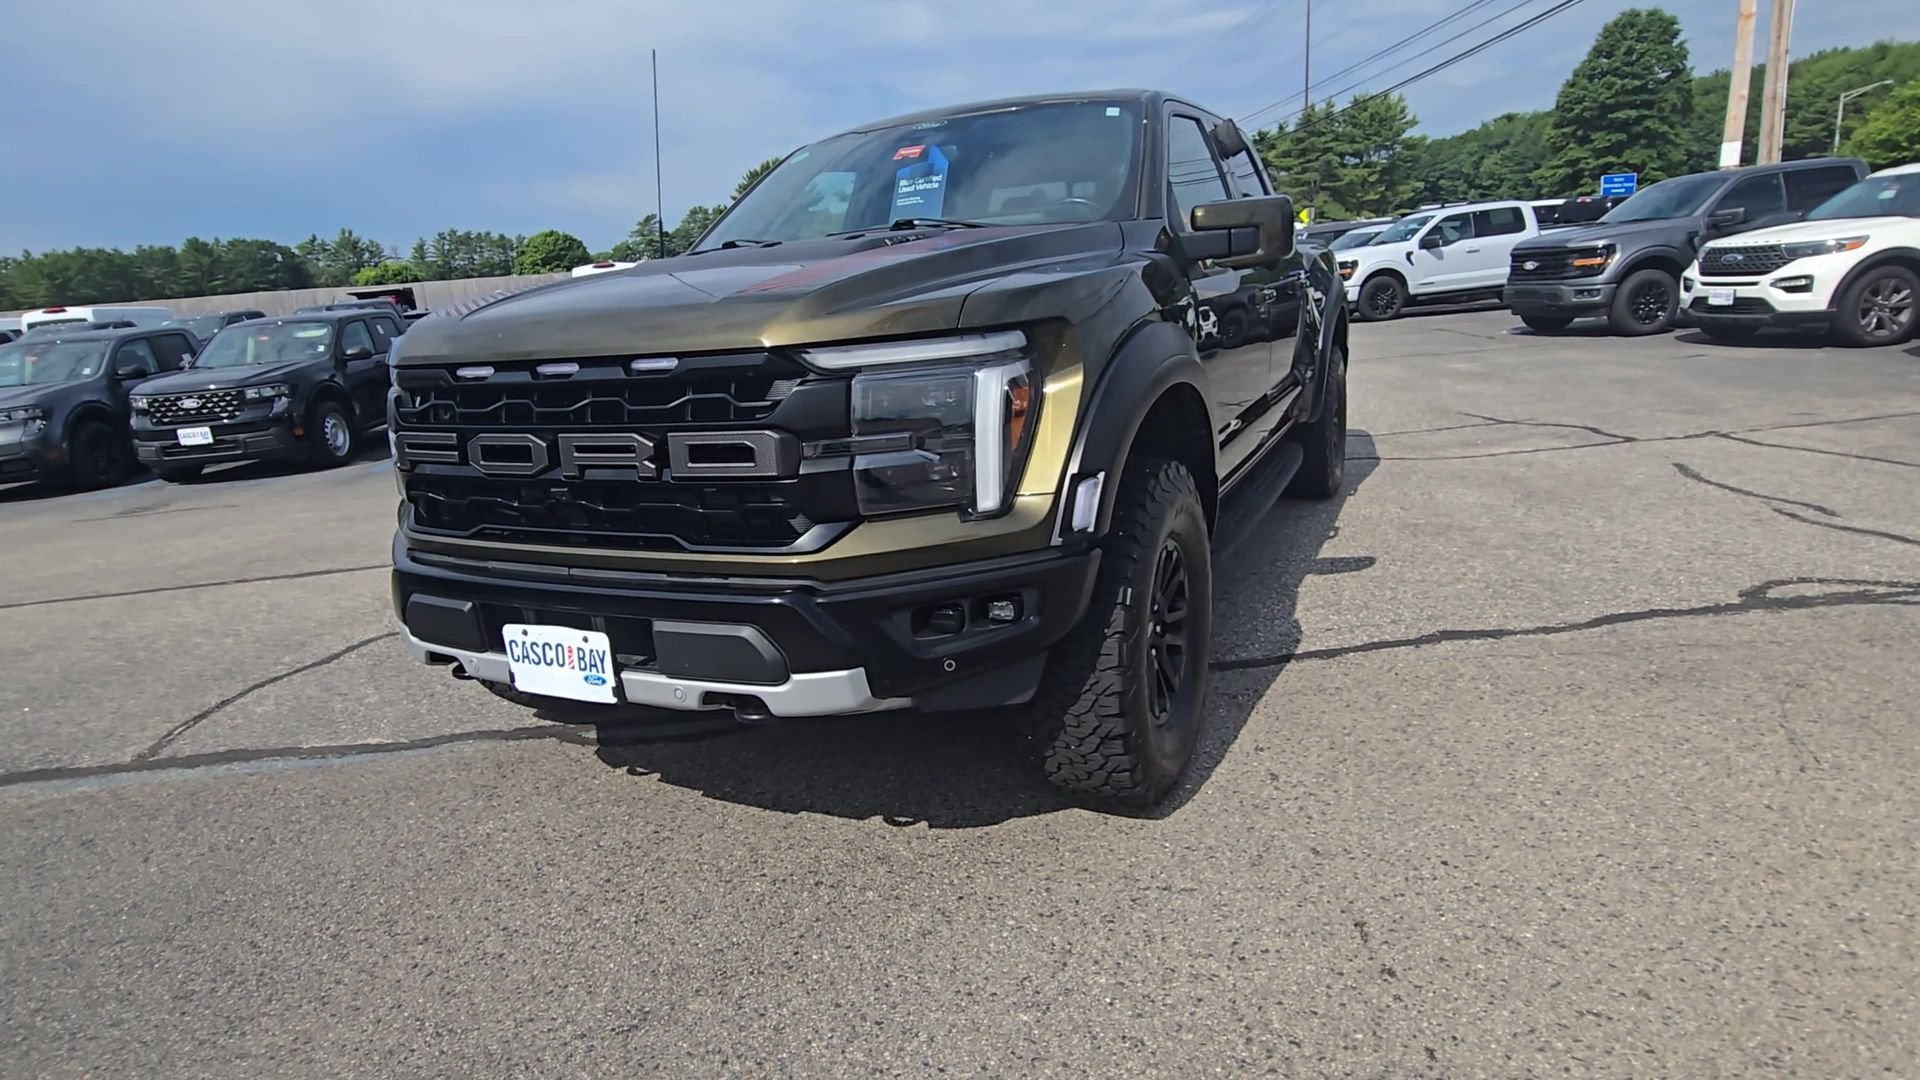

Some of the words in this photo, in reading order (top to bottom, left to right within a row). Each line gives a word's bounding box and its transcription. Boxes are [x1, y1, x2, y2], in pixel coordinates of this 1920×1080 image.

[898, 184, 915, 193] Used
[916, 182, 939, 191] Vehicle
[396, 430, 778, 478] FORD
[508, 639, 567, 668] CASCO
[576, 646, 606, 674] BAY
